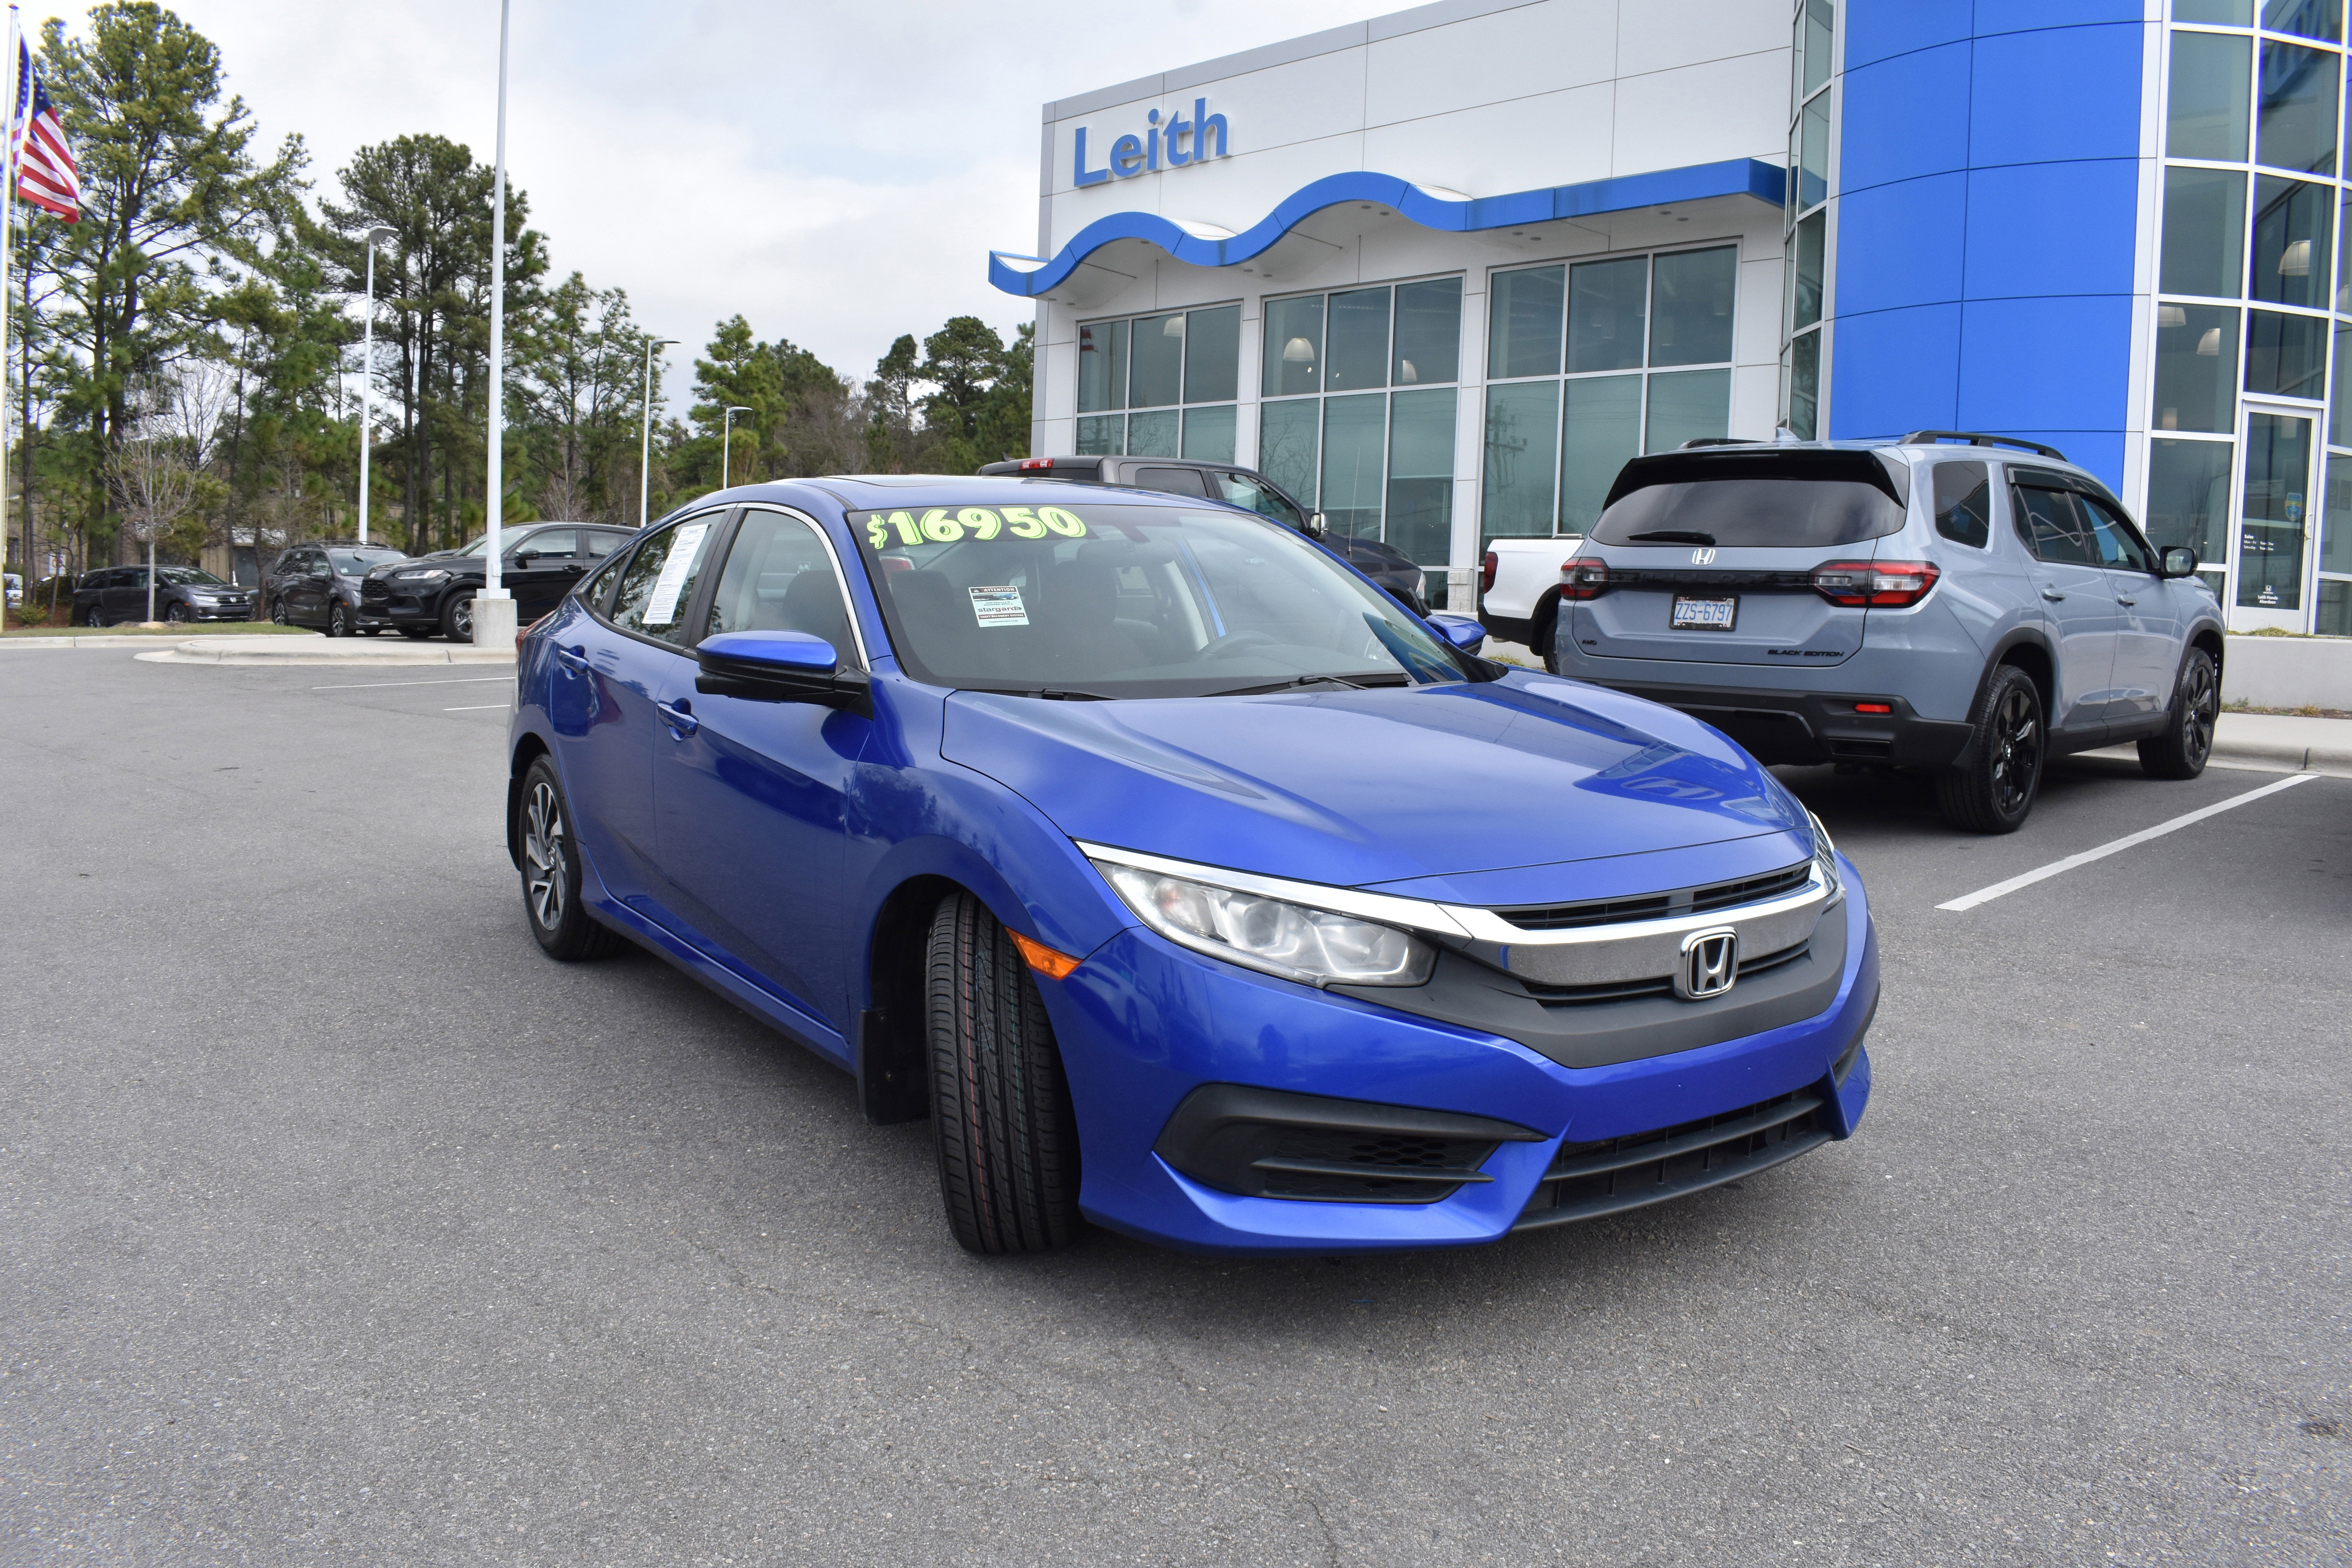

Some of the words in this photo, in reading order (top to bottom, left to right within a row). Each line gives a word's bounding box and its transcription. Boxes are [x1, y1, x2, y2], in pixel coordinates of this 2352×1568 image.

[1074, 97, 1228, 188] Leith
[866, 507, 1087, 549] $16950
[1675, 603, 1733, 621] ZZS-6797
